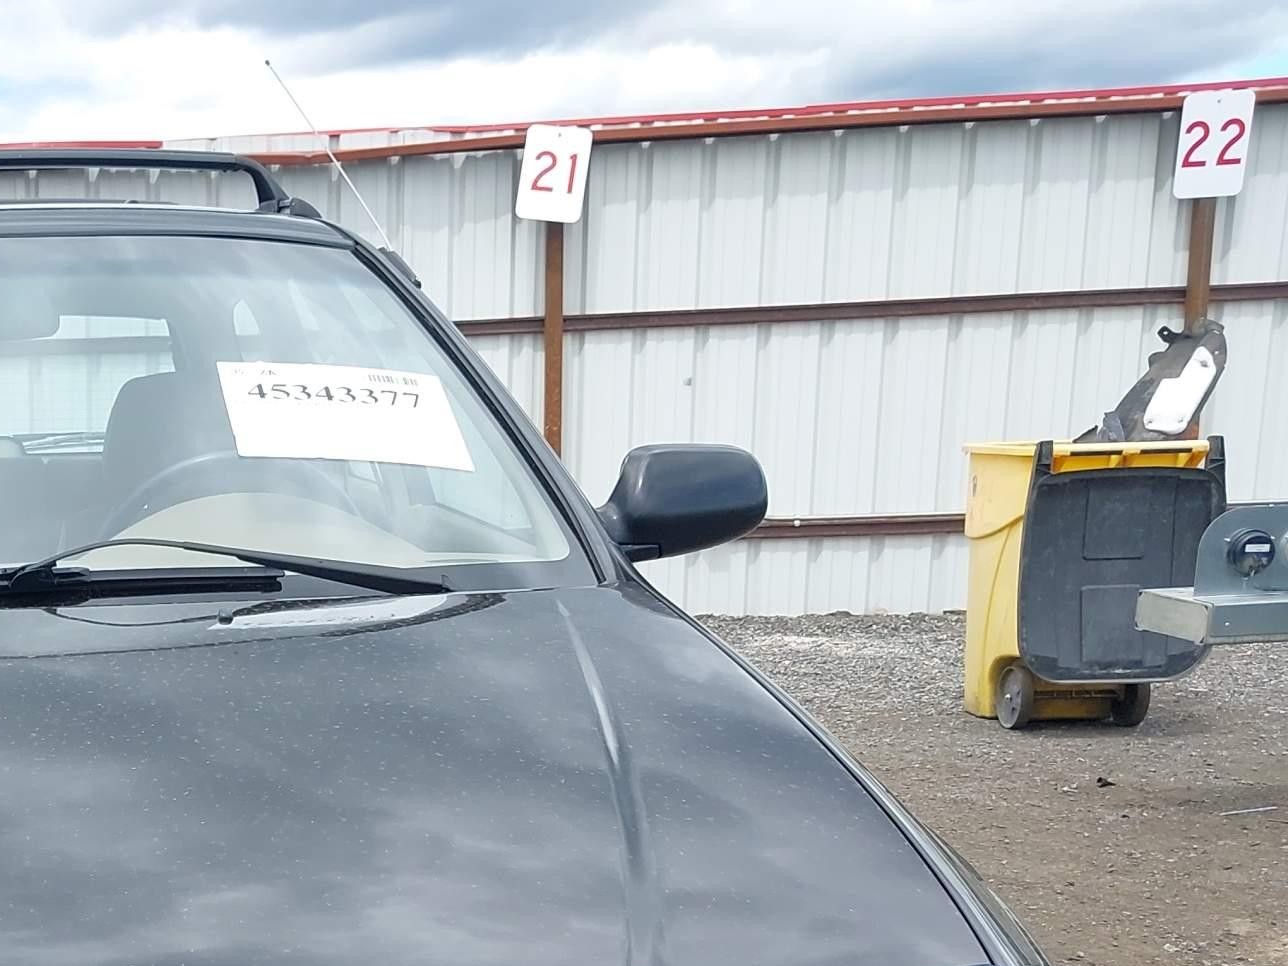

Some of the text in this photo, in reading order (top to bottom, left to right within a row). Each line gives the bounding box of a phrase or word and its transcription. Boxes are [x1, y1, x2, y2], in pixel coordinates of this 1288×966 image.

[1181, 118, 1246, 168] 22
[531, 151, 578, 194] 21
[247, 382, 420, 409] 45343377
